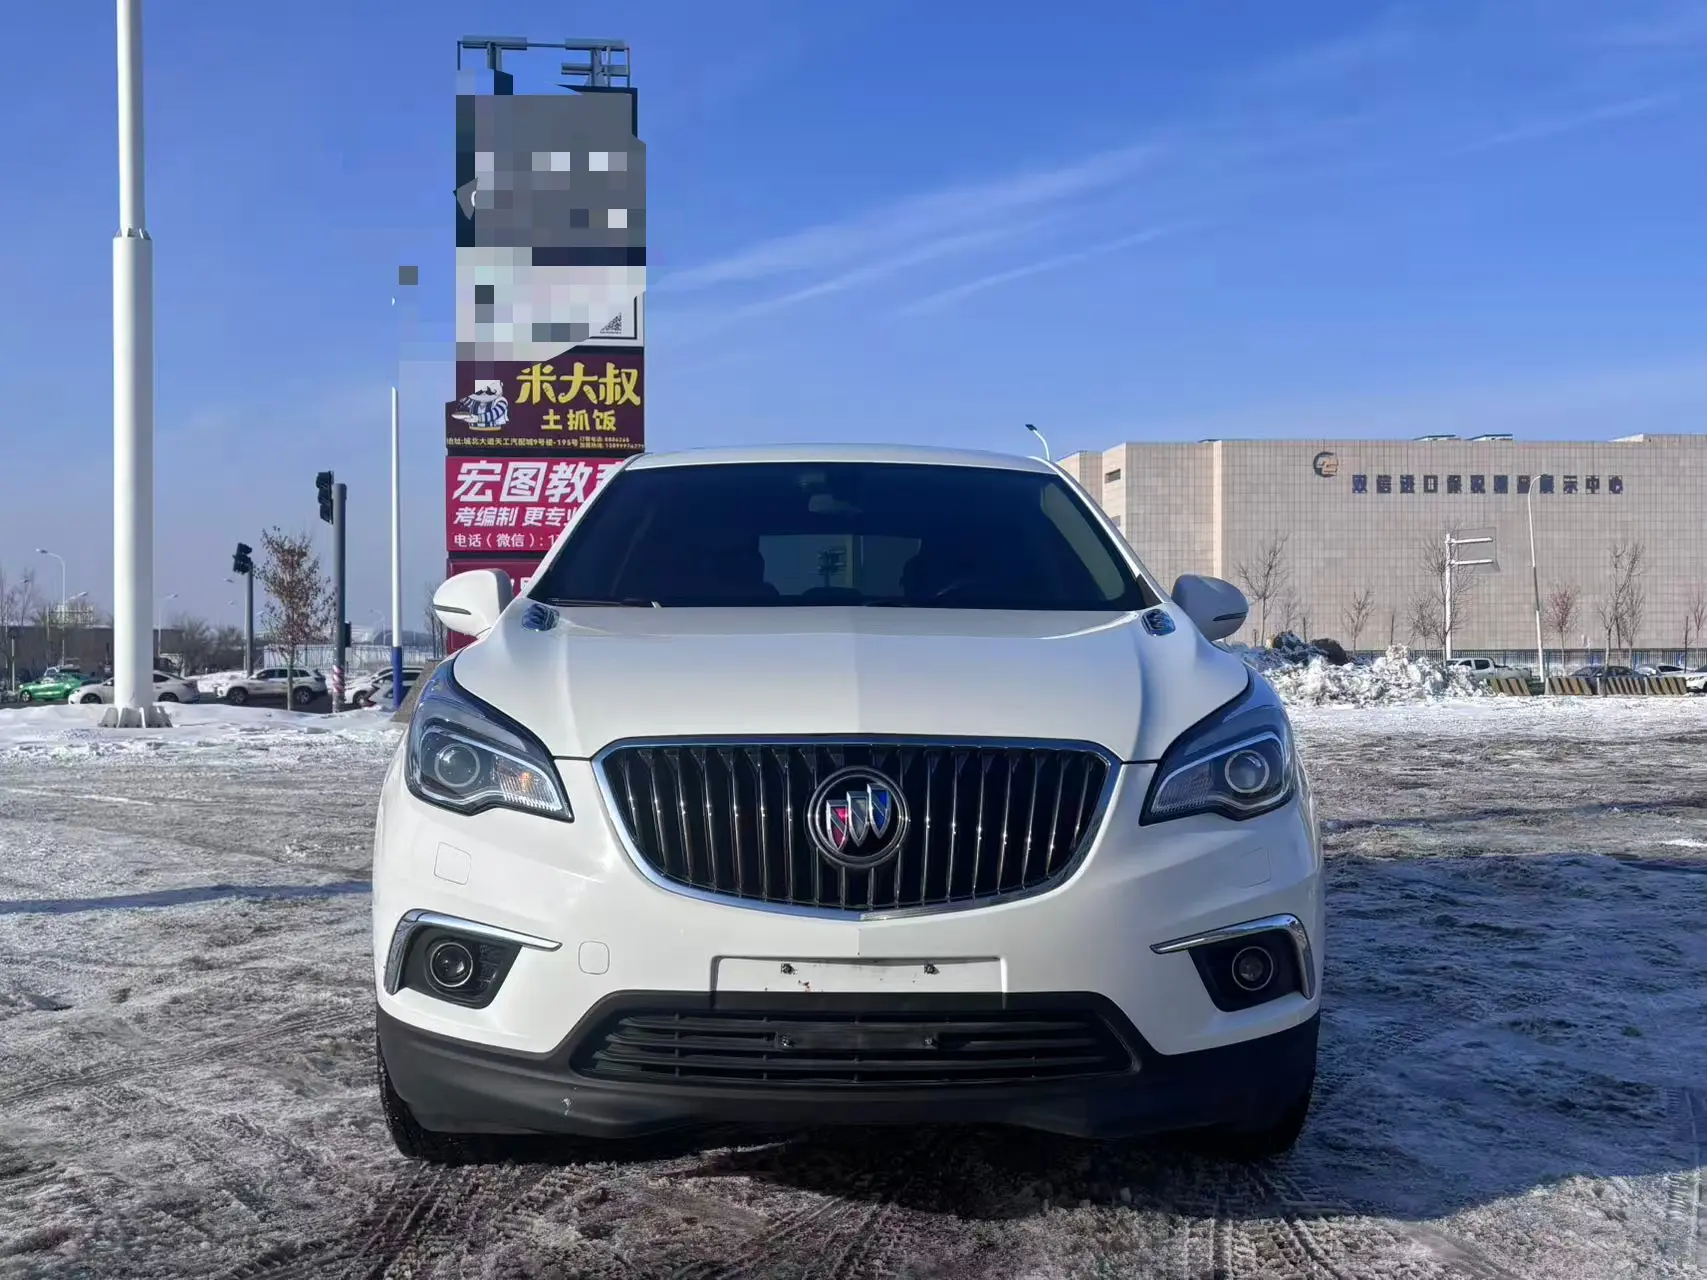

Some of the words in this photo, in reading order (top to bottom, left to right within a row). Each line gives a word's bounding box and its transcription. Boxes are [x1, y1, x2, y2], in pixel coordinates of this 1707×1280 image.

[515, 362, 641, 405] 米大叔
[541, 409, 617, 431] 土抓饭
[453, 506, 519, 527] 考编制
